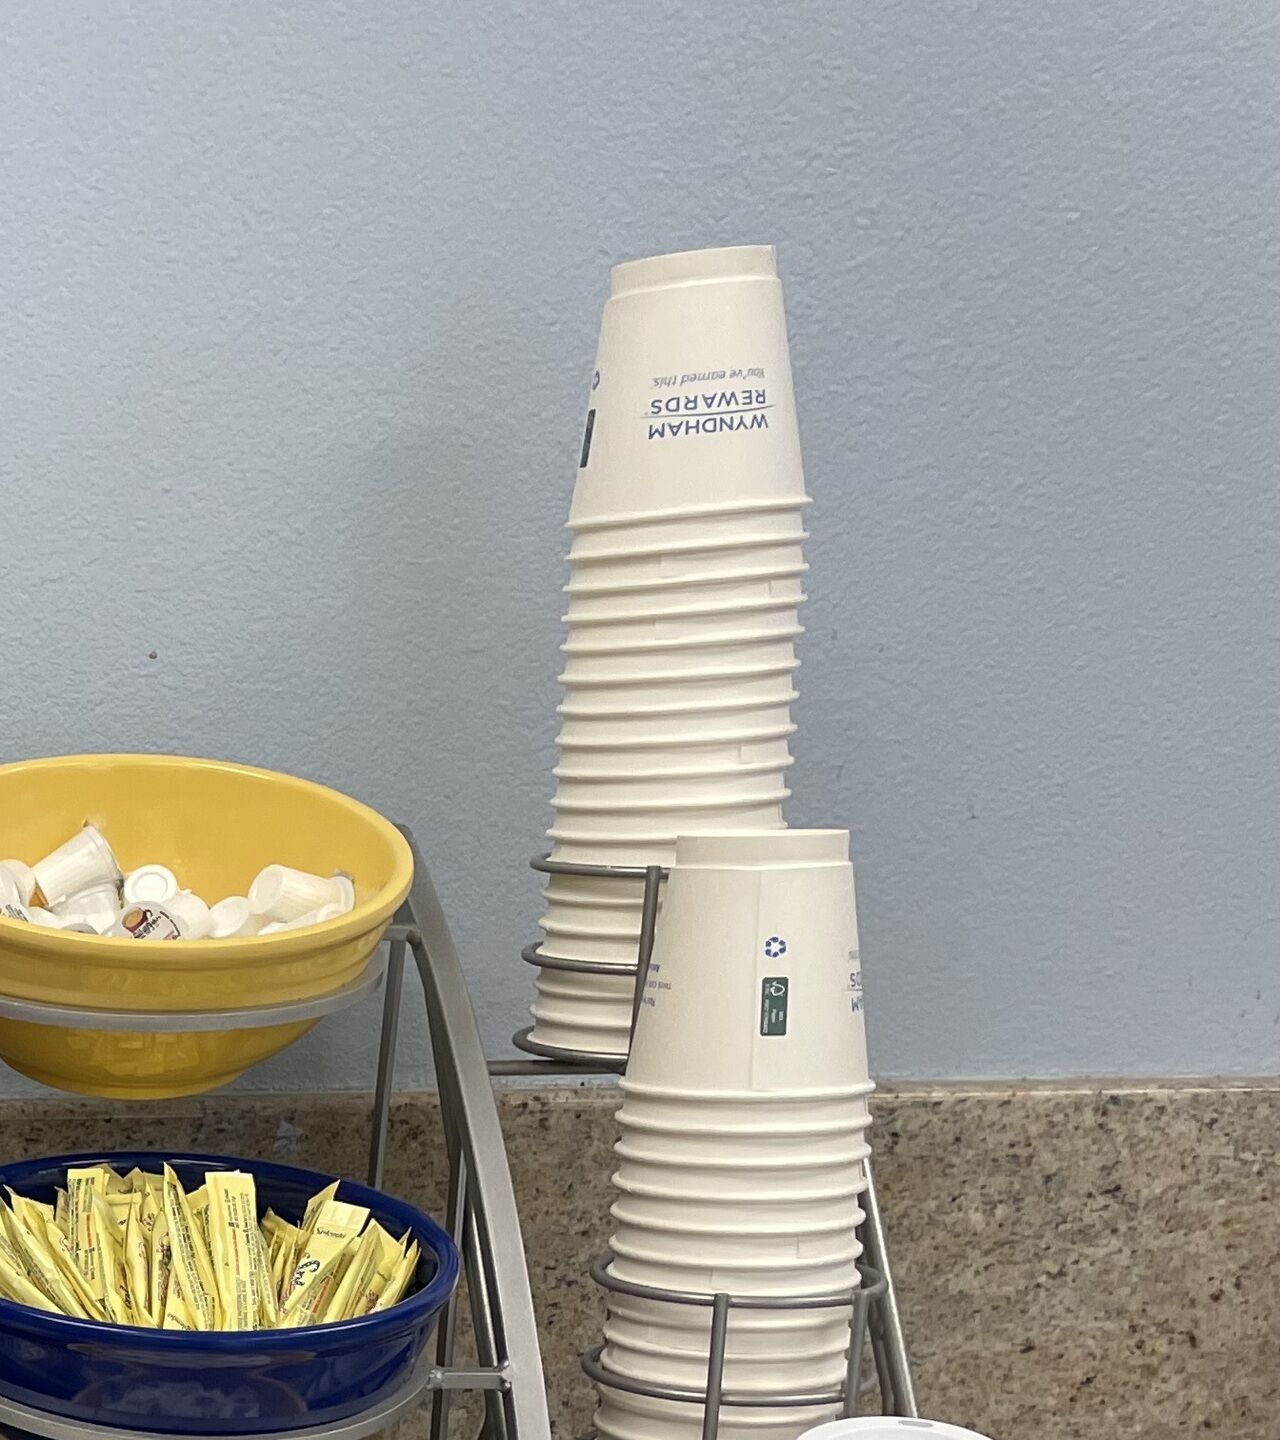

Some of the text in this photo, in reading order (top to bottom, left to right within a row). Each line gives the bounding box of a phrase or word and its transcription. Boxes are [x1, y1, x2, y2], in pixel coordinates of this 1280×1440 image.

[680, 370, 726, 386] earned
[650, 389, 766, 415] REWARDS
[648, 413, 769, 440] WYNDHAM
